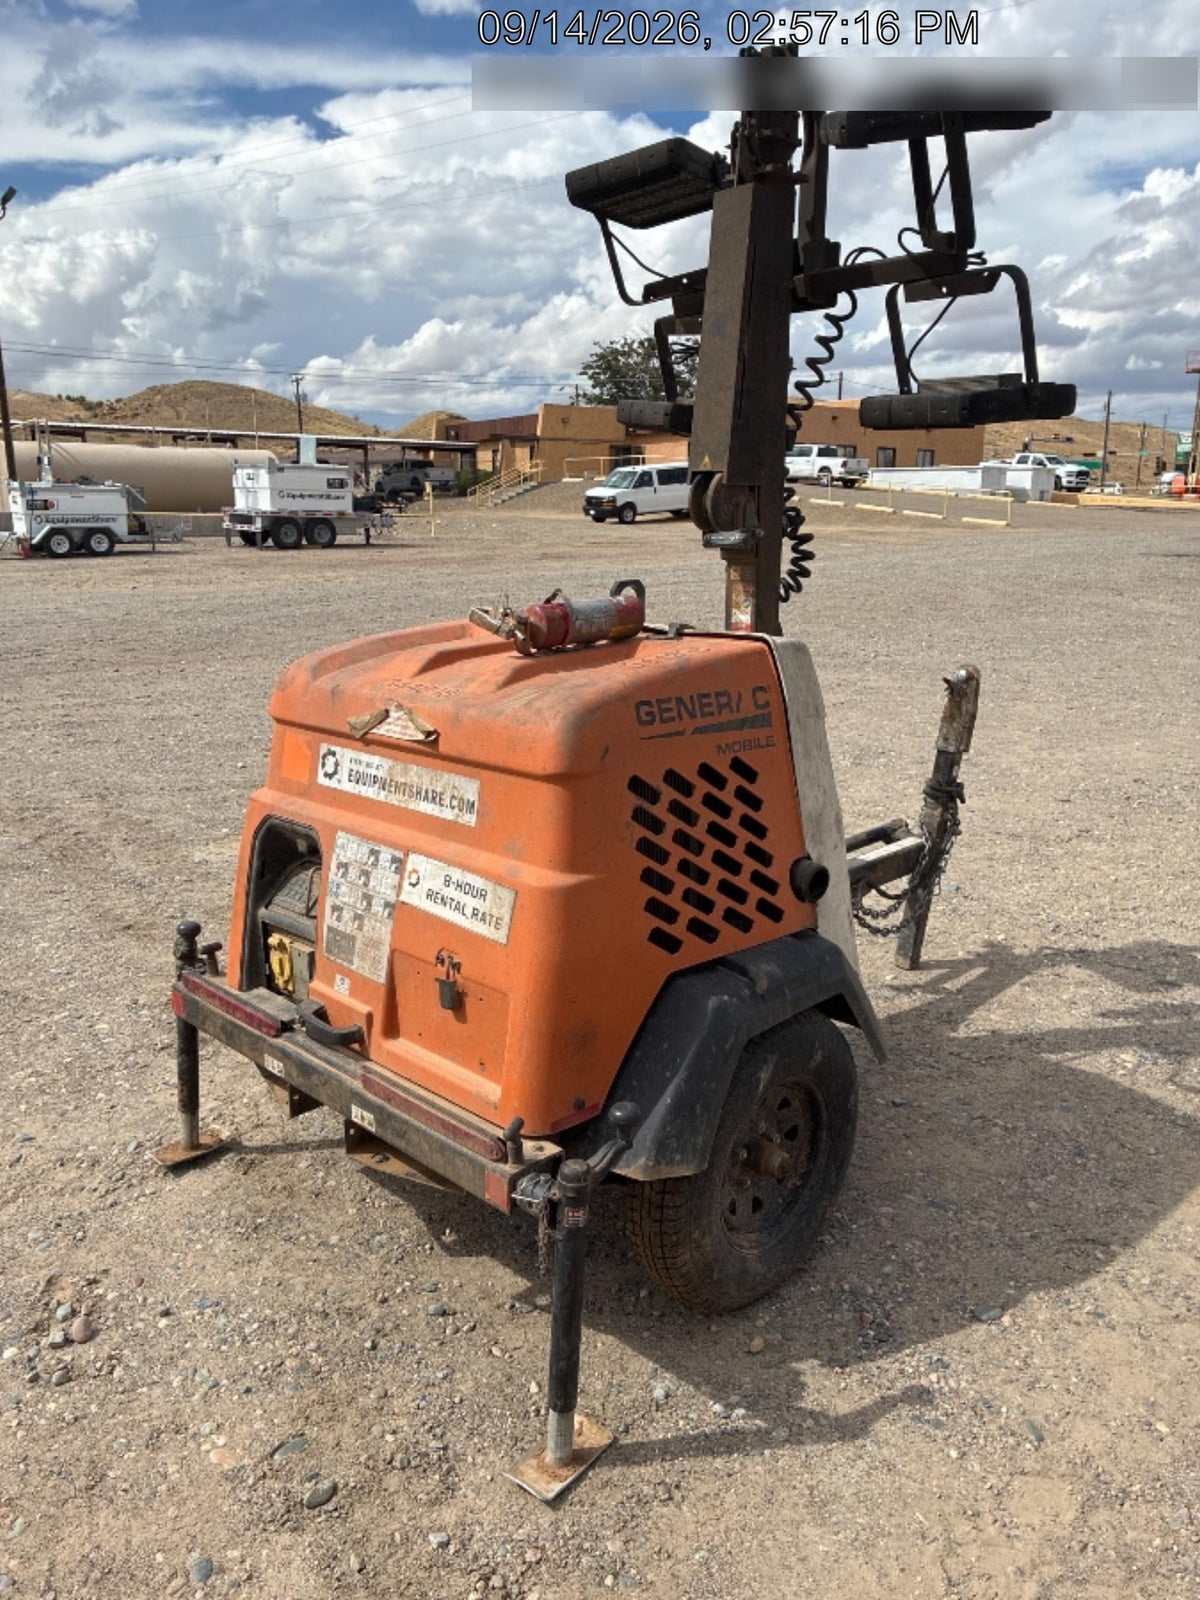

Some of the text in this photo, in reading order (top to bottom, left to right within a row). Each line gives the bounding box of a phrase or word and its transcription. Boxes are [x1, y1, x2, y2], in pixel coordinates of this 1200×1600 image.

[716, 735, 776, 755] MOBILE
[347, 768, 476, 815] EQUIPMENTSHARE.COM
[443, 874, 488, 903] 8-HOUR
[425, 888, 504, 932] RENTAL RATE
